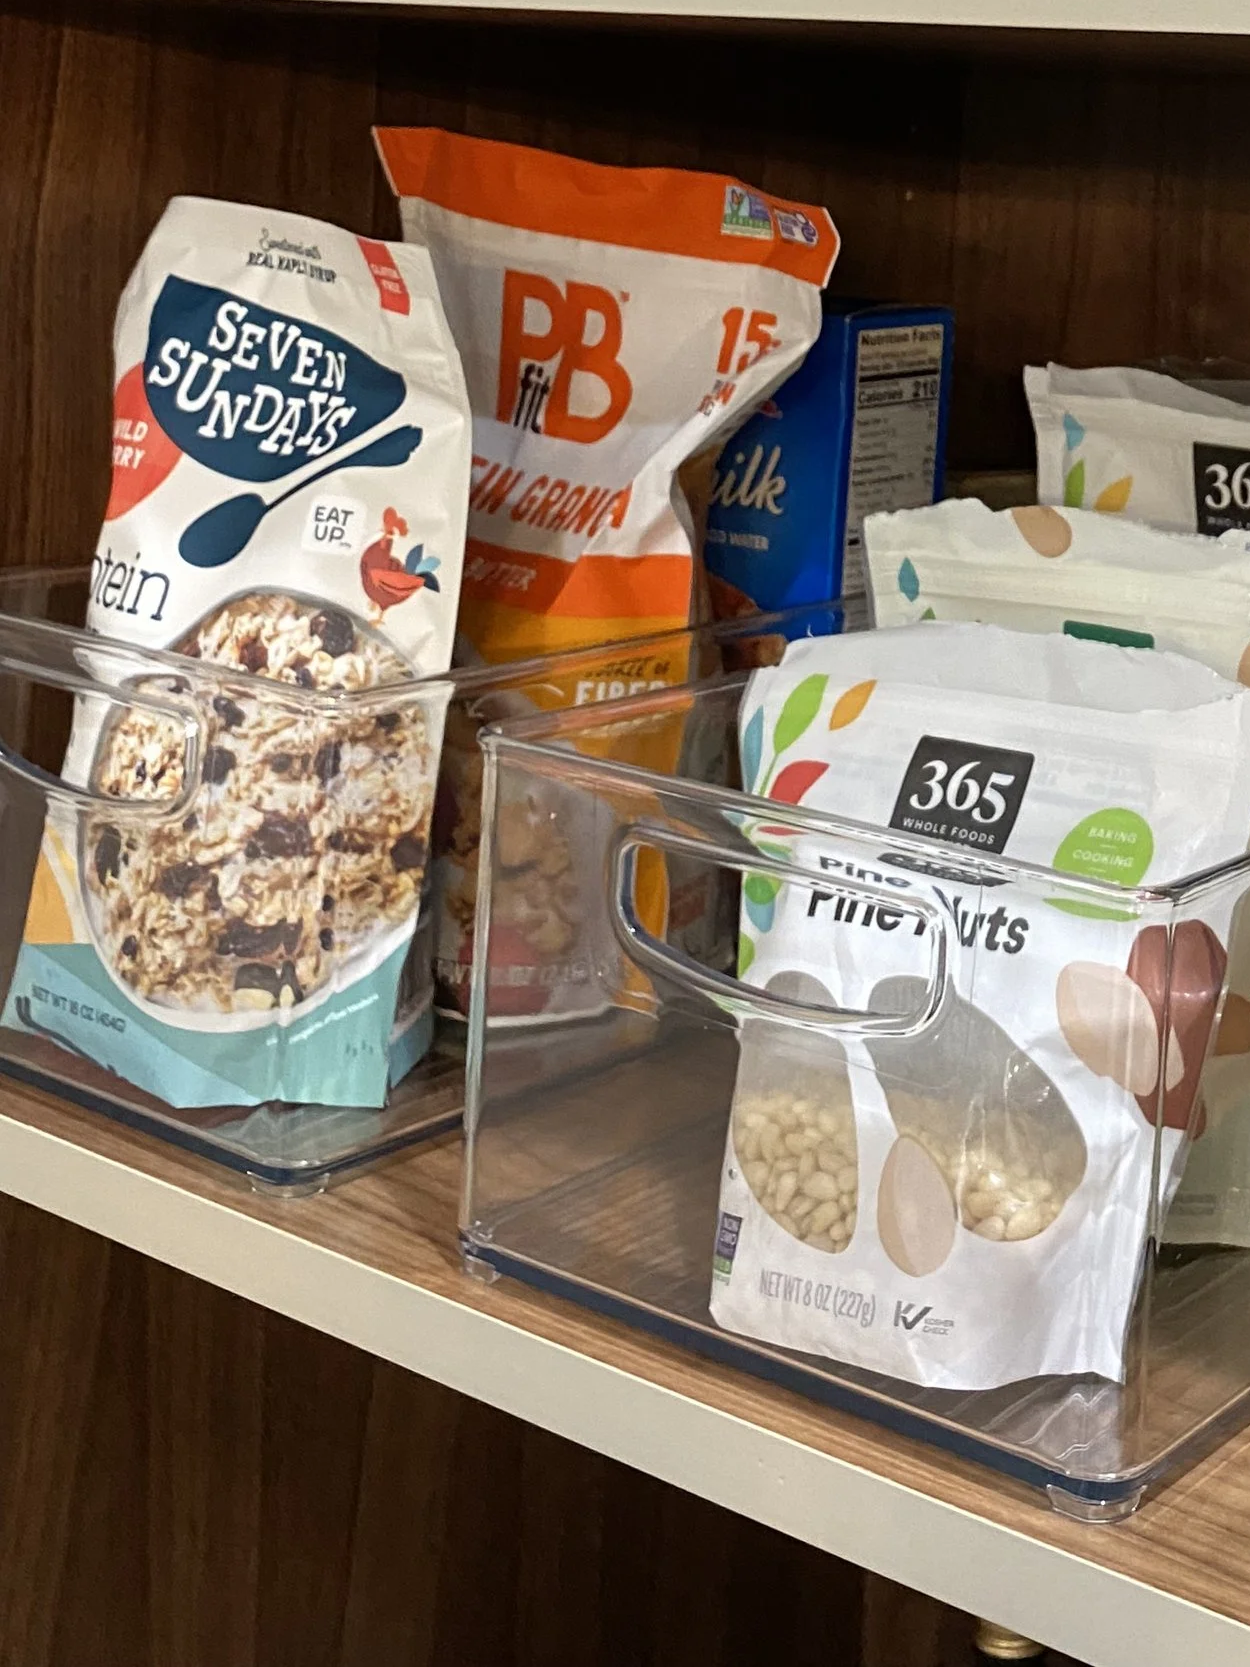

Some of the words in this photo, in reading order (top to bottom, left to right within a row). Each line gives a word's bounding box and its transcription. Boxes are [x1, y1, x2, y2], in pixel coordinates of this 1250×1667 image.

[208, 300, 348, 391] SEVEN
[147, 337, 358, 457] SUNDAYS
[712, 444, 787, 516] ilk
[315, 506, 354, 527] EAT
[315, 522, 345, 544] UP
[909, 759, 1016, 824] 365
[902, 816, 947, 836] WHOLE
[951, 824, 996, 845] FOODS
[1072, 849, 1134, 869] COOKING
[759, 1268, 782, 1298] NET
[782, 1275, 801, 1303] WT
[815, 1282, 833, 1312] OZ
[835, 1286, 876, 1328] (227g)
